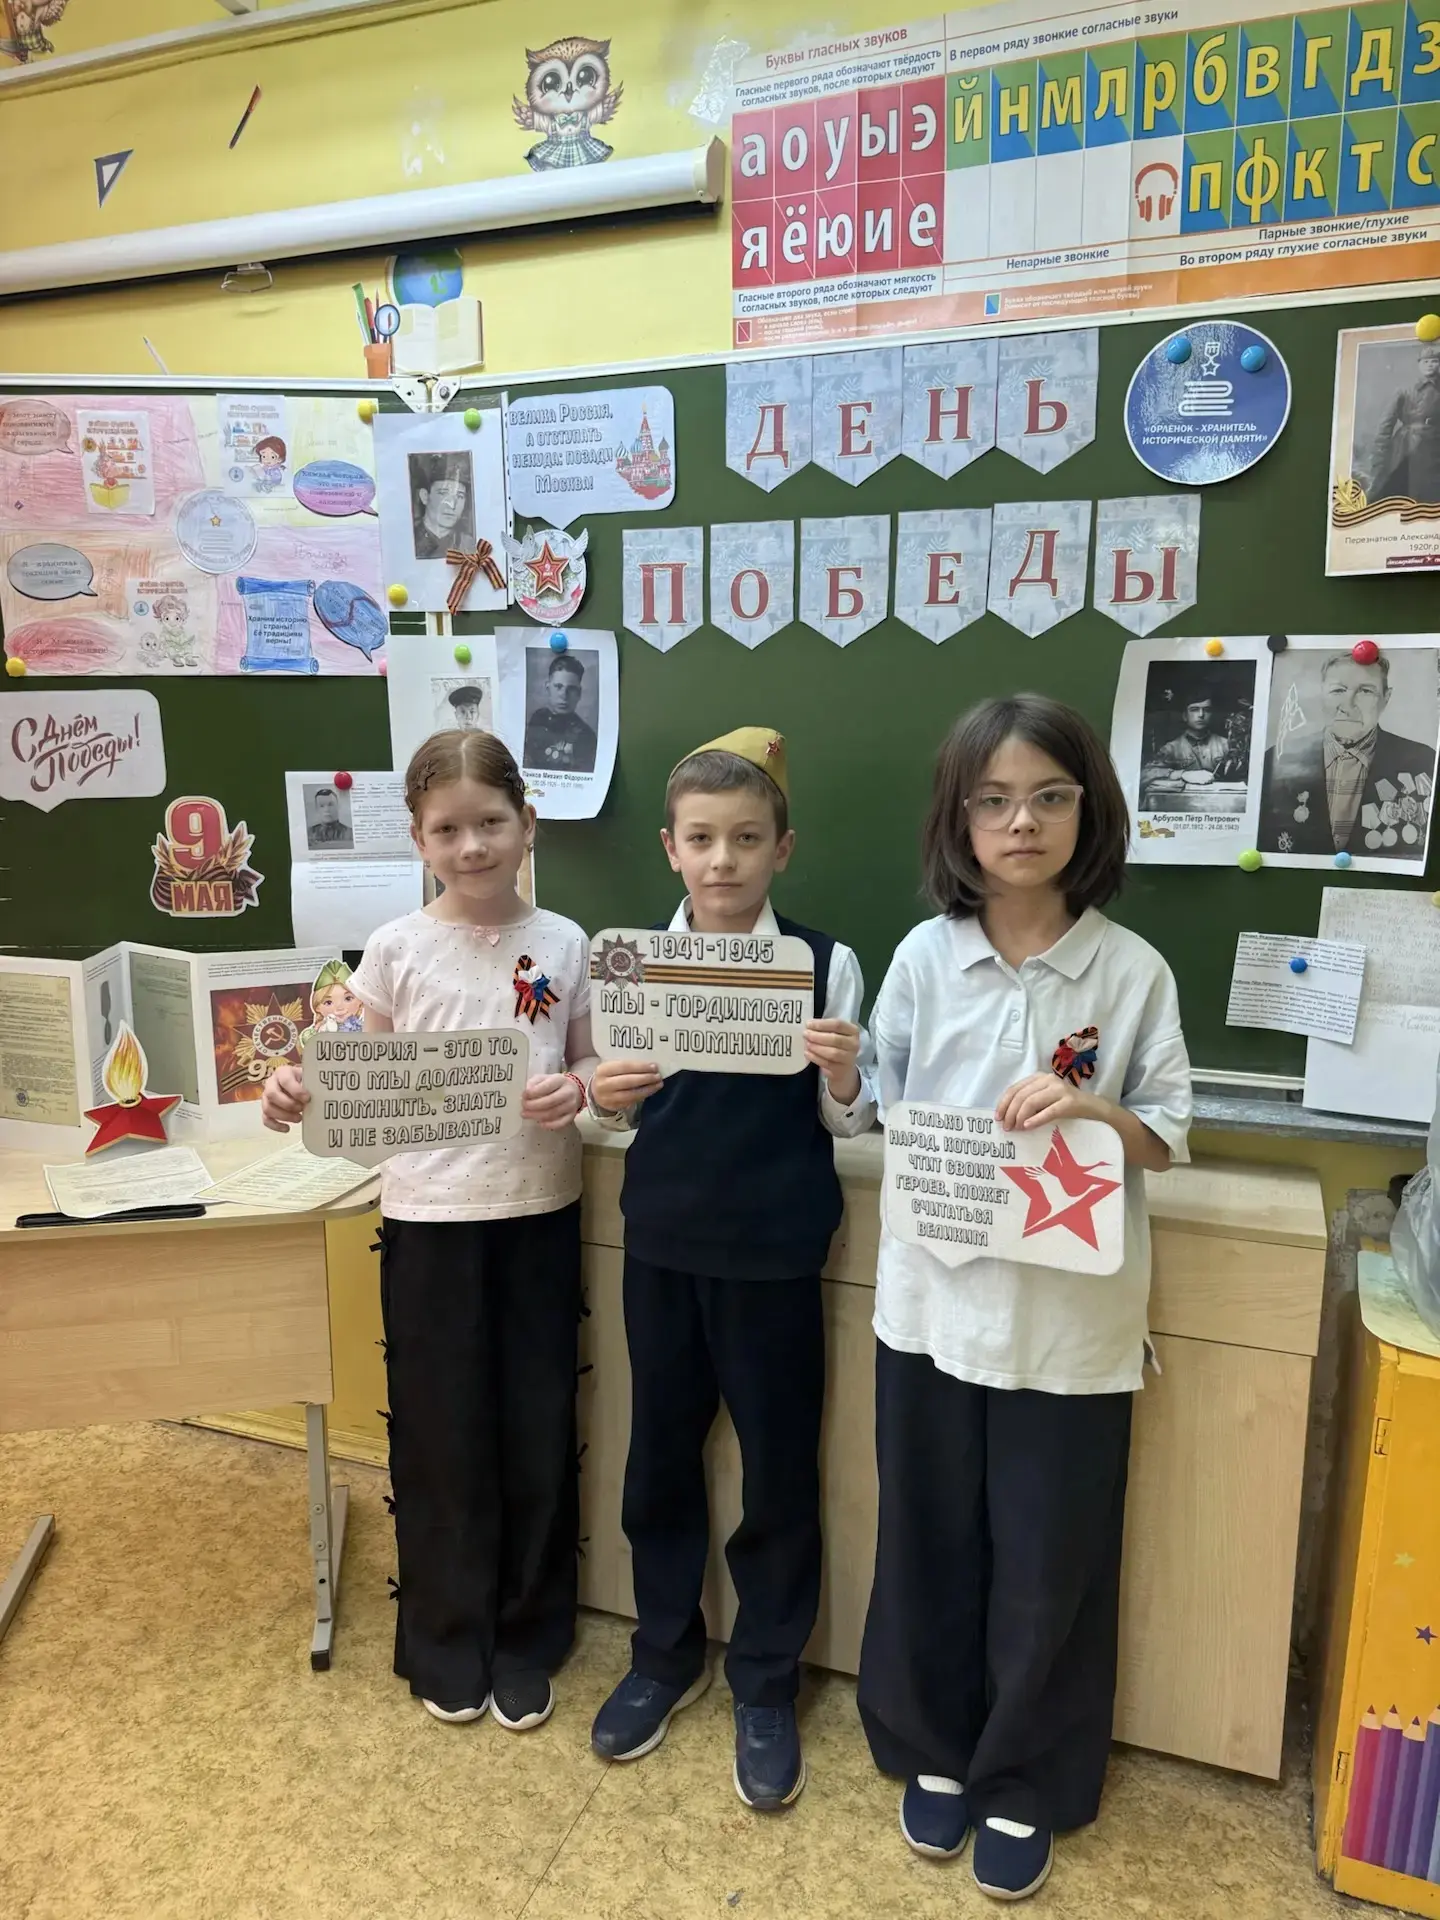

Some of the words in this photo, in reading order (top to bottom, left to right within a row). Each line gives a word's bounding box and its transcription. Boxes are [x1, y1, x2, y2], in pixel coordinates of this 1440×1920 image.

[766, 50, 805, 70] Буквы
[808, 38, 860, 60] гласных
[864, 28, 908, 48] звуков
[949, 49, 956, 61] В
[960, 43, 1000, 59] первом
[1003, 37, 1030, 53] ряду
[1033, 28, 1078, 45] звонкие
[1082, 15, 1141, 36] согласные
[1144, 9, 1178, 24] звуки
[735, 82, 772, 97] Гласные
[774, 76, 810, 92] первого
[812, 71, 834, 84] ряда
[836, 60, 891, 78] обозначают
[893, 49, 942, 66] твёрдость
[741, 92, 787, 107] согласных
[789, 86, 821, 100] звуков,
[823, 80, 850, 91] после
[852, 71, 893, 86] которых
[894, 62, 936, 78] следуют
[1192, 31, 1229, 107] б
[1258, 225, 1307, 241] Парные
[1309, 213, 1410, 235] звонкие/глухие
[1006, 253, 1062, 270] Непарные
[1064, 247, 1110, 263] звонкие
[1179, 254, 1195, 267] Во
[1198, 249, 1242, 266] втором
[1245, 246, 1274, 263] ряду
[1278, 241, 1320, 257] глухие
[1323, 234, 1387, 251] согласные
[1391, 229, 1428, 246] звуки
[738, 290, 775, 303] Гласные
[777, 287, 811, 302] второго
[813, 284, 835, 296] ряда
[837, 277, 892, 292] обозначают
[894, 272, 937, 286] мягкость
[741, 301, 787, 313] согласных
[789, 296, 821, 309] звуков,
[823, 292, 849, 303] после
[851, 288, 890, 301] которых
[892, 283, 933, 298] следуют
[745, 378, 1069, 471] ДЕНЬ
[1142, 433, 1219, 445] ИСТОРИЧЕСКОЙ
[1220, 433, 1268, 445] ПАМЯТИ»
[1200, 423, 1257, 433] ХРАНИТЕЛЬ
[1345, 535, 1398, 545] Перезнатнов
[1400, 532, 1440, 541] Александ
[638, 528, 1181, 626] ПОБЕДЫ
[11, 717, 38, 764] С
[38, 713, 98, 752] Днём
[30, 712, 141, 793] Победы!
[1152, 814, 1184, 824] Арбузов
[1204, 814, 1241, 824] Петрович
[169, 801, 223, 870] 9
[171, 880, 235, 913] МАЯ
[650, 935, 774, 963] 1941-1945
[600, 989, 645, 1015] МЫ
[665, 993, 803, 1024] ГОРДИМСЯ!
[316, 1040, 418, 1062] ИСТОРИЯ
[444, 1037, 482, 1059] ЭТО
[610, 1024, 653, 1050] МЫ
[674, 1029, 793, 1057] ПОМНИМ!
[247, 1059, 268, 1081] 9
[319, 1070, 360, 1091] ЧТО
[367, 1069, 410, 1091] МЫ
[416, 1063, 513, 1092] ДОЛЖНЫ
[324, 1097, 437, 1120] ПОМНИТЬ,
[443, 1091, 507, 1114] ЗНАТЬ
[328, 1128, 343, 1148] И
[349, 1127, 377, 1147] НЕ
[382, 1116, 502, 1146] ЗАБЫВАТЬ!
[909, 1109, 964, 1132] ТОЛЬКО
[966, 1116, 994, 1134] ТОТ
[889, 1129, 940, 1153] НАРОД,
[943, 1135, 1016, 1160] КОТОРЫЙ
[908, 1153, 942, 1174] ЧТИТ
[945, 1157, 996, 1181] СВОИХ
[895, 1174, 951, 1198] ГЕРОЕВ,
[953, 1182, 1010, 1205] МОЖЕТ
[911, 1198, 994, 1226] СЧИТАТЬСЯ
[916, 1220, 989, 1247] ВЕЛИКИМ
